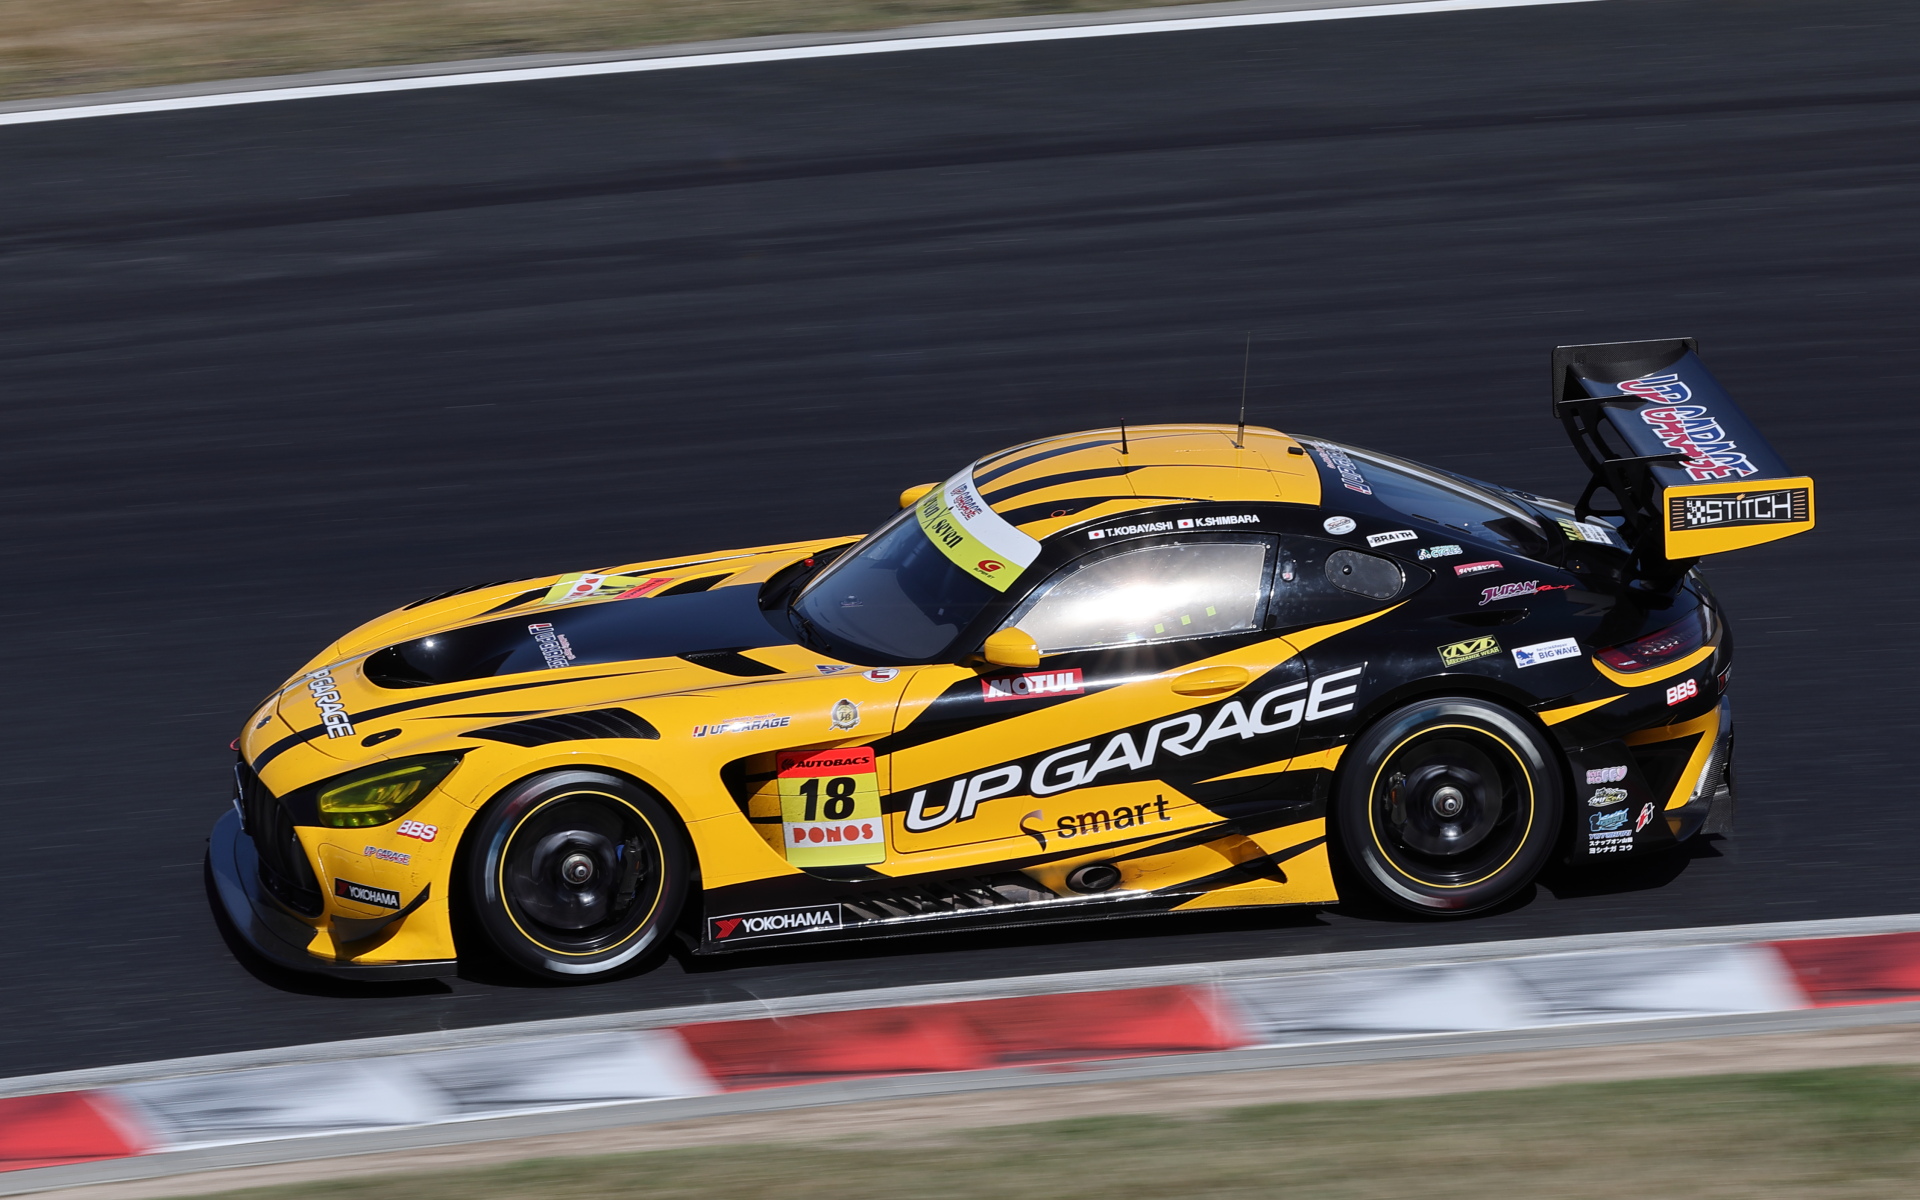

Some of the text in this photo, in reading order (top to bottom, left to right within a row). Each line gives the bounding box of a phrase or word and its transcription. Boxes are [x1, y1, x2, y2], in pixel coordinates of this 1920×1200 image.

[1617, 373, 1759, 481] UP GARAGE
[1706, 492, 1791, 523] STITCH
[1106, 521, 1173, 537] T.KOBAYASHI
[1195, 514, 1260, 528] K.SHIMBARA
[932, 518, 963, 549] seven
[1478, 580, 1538, 606] JURAN
[1446, 646, 1500, 666] MECHANIX WEAR
[1538, 645, 1579, 660] BIG WAVE
[988, 672, 1079, 698] MOTUL
[1666, 678, 1698, 706] BBS
[308, 677, 355, 739] GARAGE
[710, 724, 728, 735] UP
[904, 665, 1363, 831] UP GARAGE
[795, 756, 870, 769] AUTOBACS
[799, 776, 856, 821] 18
[1057, 793, 1172, 840] smart
[396, 820, 438, 842] BBS
[793, 823, 874, 844] PONOS
[363, 845, 412, 866] UP GARAGE
[348, 885, 399, 907] YOKOHAMA
[742, 910, 834, 933] YOKOHAMA
